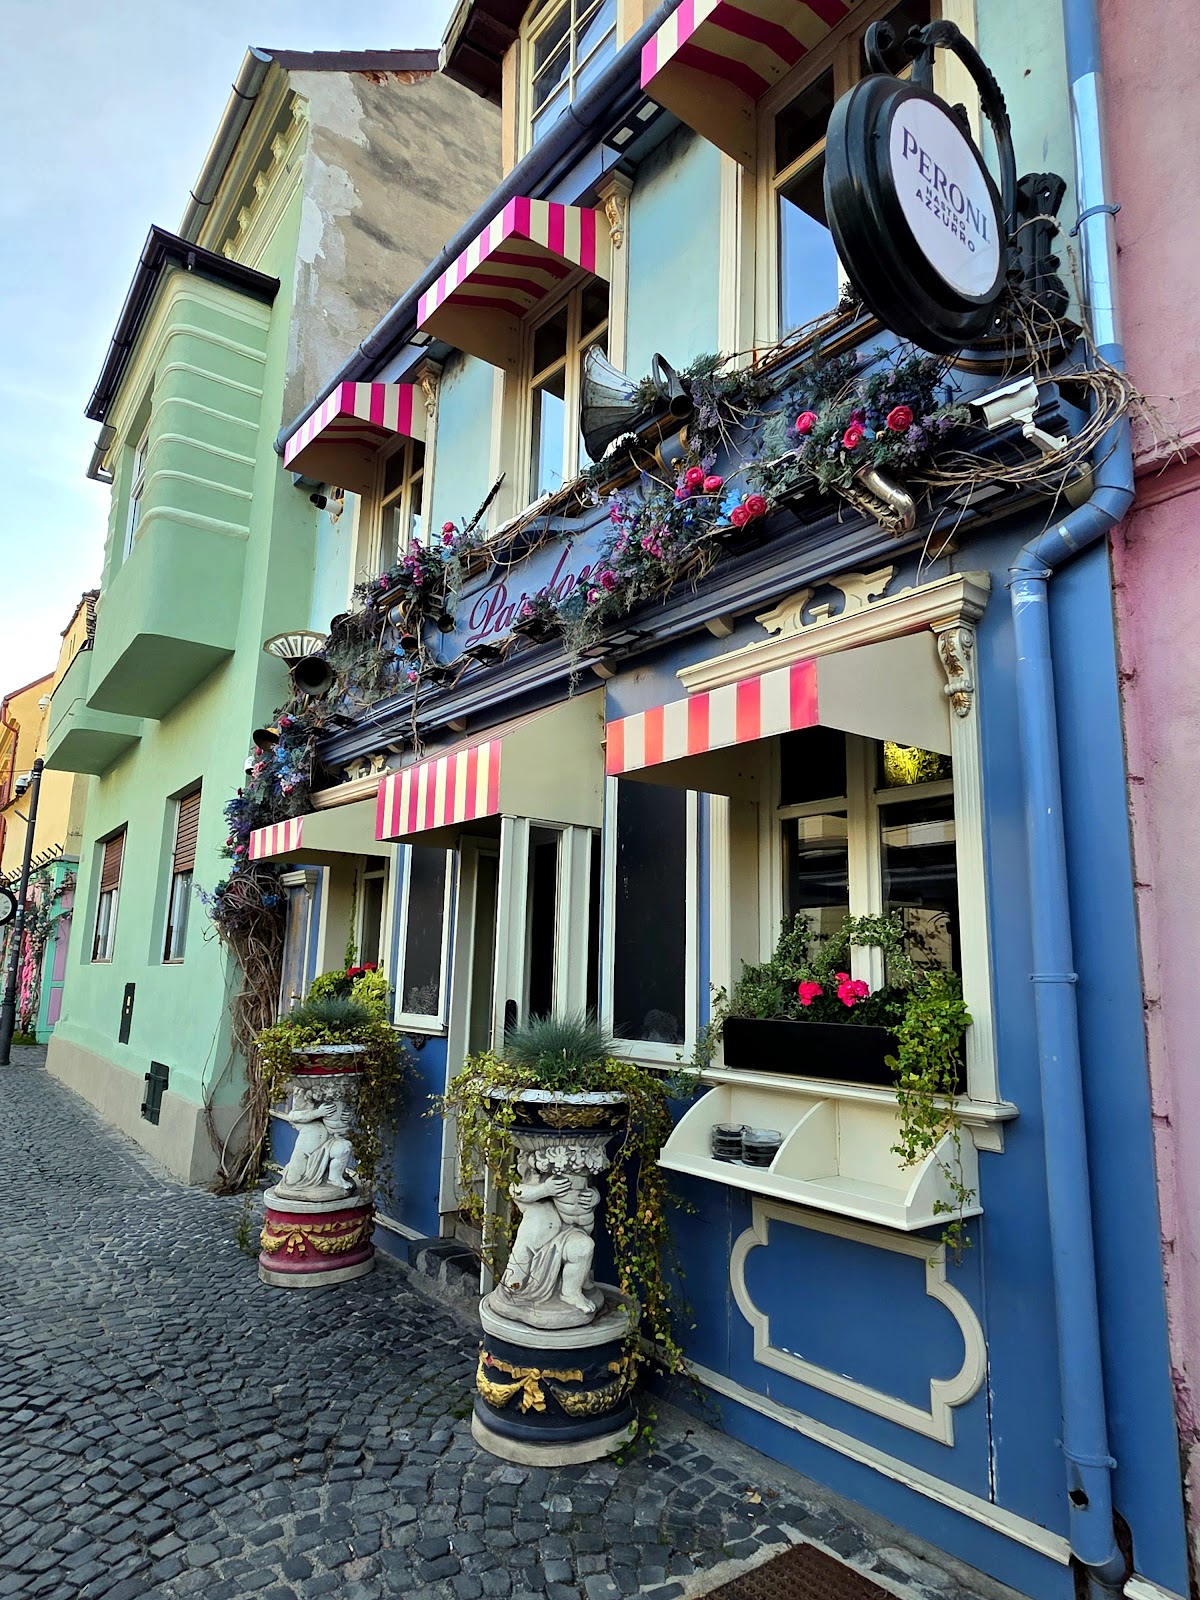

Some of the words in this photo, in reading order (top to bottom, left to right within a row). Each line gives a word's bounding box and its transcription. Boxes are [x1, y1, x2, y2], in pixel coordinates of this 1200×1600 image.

[902, 126, 988, 241] PERONI
[926, 185, 966, 231] NASTRO
[915, 188, 976, 253] AZZURRO
